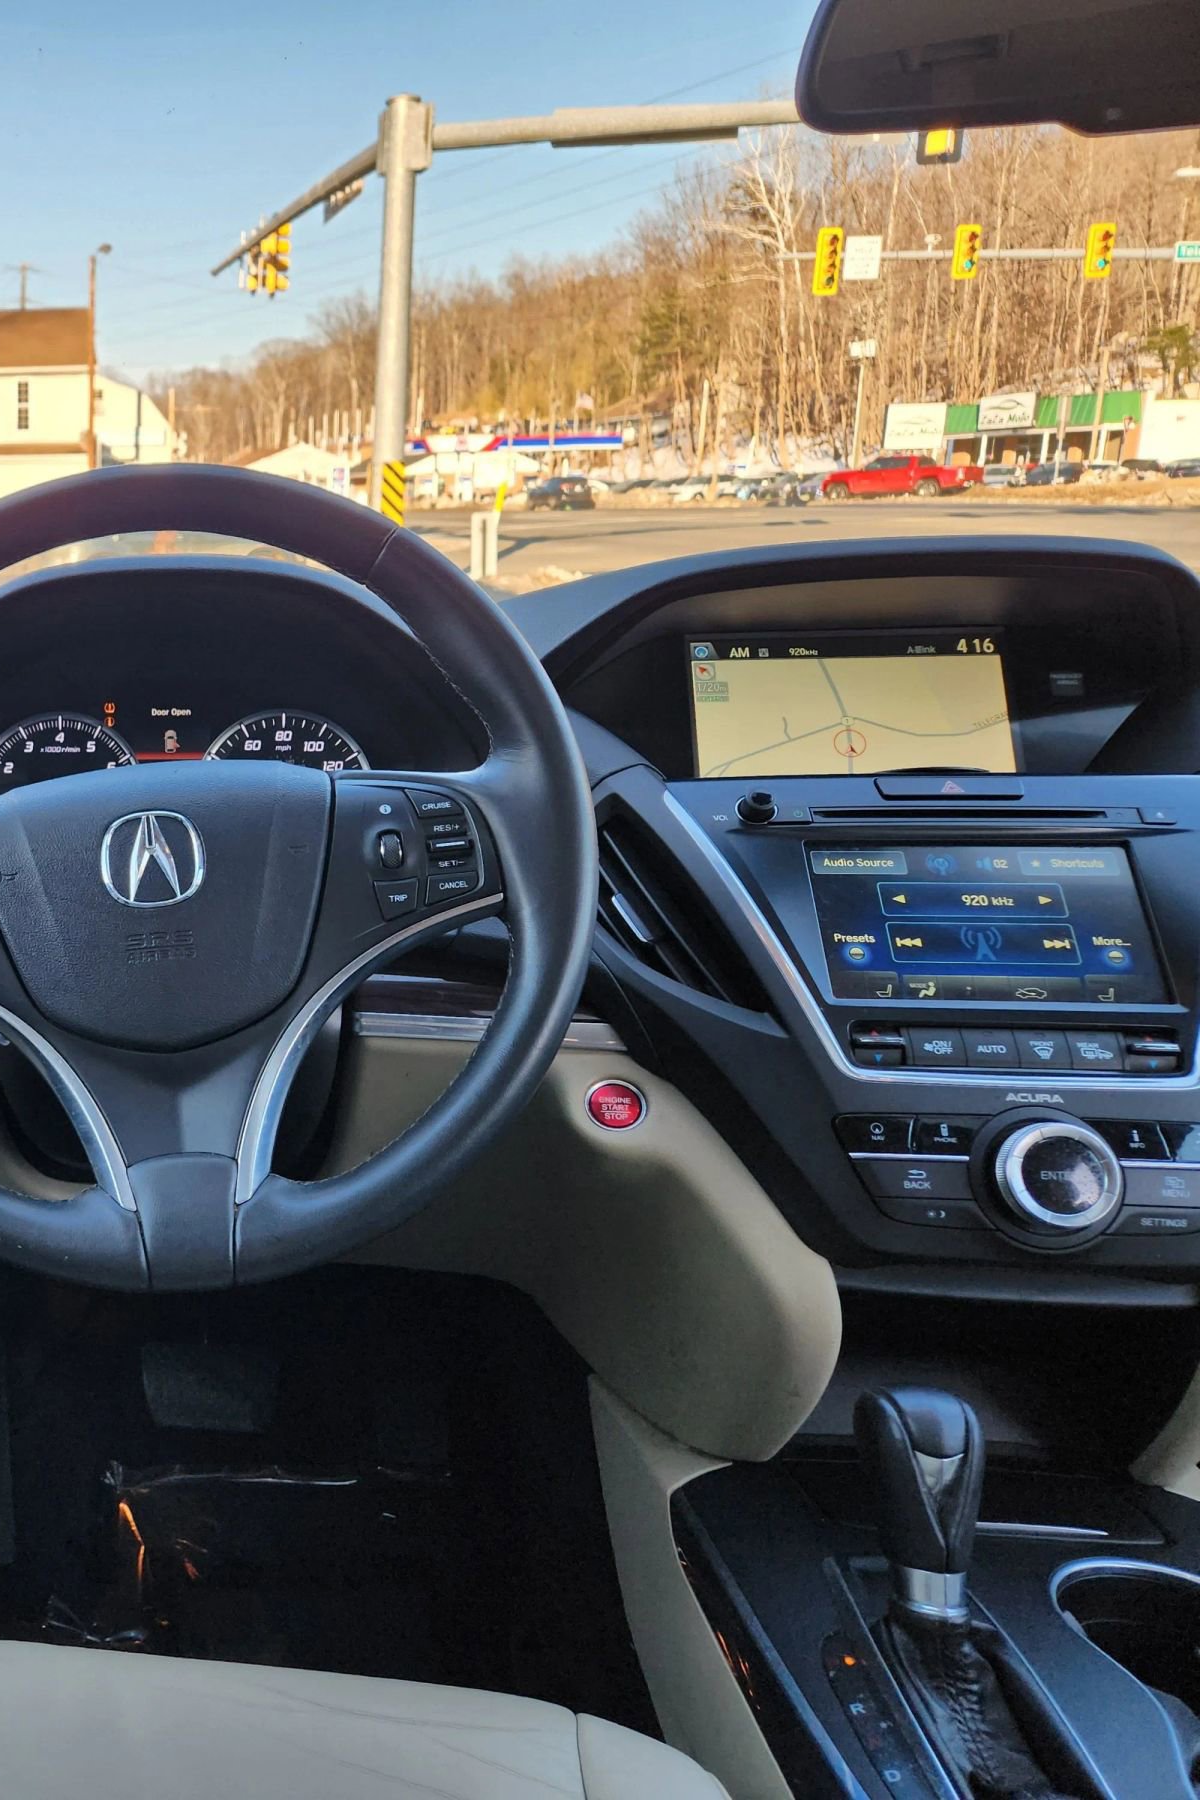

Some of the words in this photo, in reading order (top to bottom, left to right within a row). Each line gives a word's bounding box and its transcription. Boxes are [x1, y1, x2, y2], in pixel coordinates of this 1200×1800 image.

[729, 647, 750, 658] AM
[151, 707, 170, 717] Door
[171, 707, 192, 718] Open
[54, 732, 65, 743] 4
[275, 730, 293, 742] 80
[23, 741, 34, 753] 3
[86, 740, 97, 753] 5
[244, 739, 262, 751] 60
[275, 744, 292, 752] mph
[303, 740, 325, 752] 100
[3, 762, 14, 774] 2
[322, 760, 344, 772] 120
[421, 801, 452, 811] CRUISE
[823, 857, 854, 867] Audio
[856, 857, 894, 867] Source
[993, 859, 1009, 869] 02
[439, 880, 469, 890] CANCEL
[388, 894, 408, 903] TRIP
[961, 895, 989, 906] 920
[991, 896, 1015, 906] kHz
[833, 932, 876, 943] Presets
[977, 1044, 1007, 1054] AUTO
[1029, 1040, 1055, 1048] FRONT
[599, 1096, 632, 1104] ENGINE
[1005, 1092, 1065, 1104] ACURA
[604, 1112, 628, 1120] STOP
[903, 1180, 931, 1190] BACK
[1140, 1217, 1188, 1228] SETTINGS
[849, 1702, 867, 1716] R
